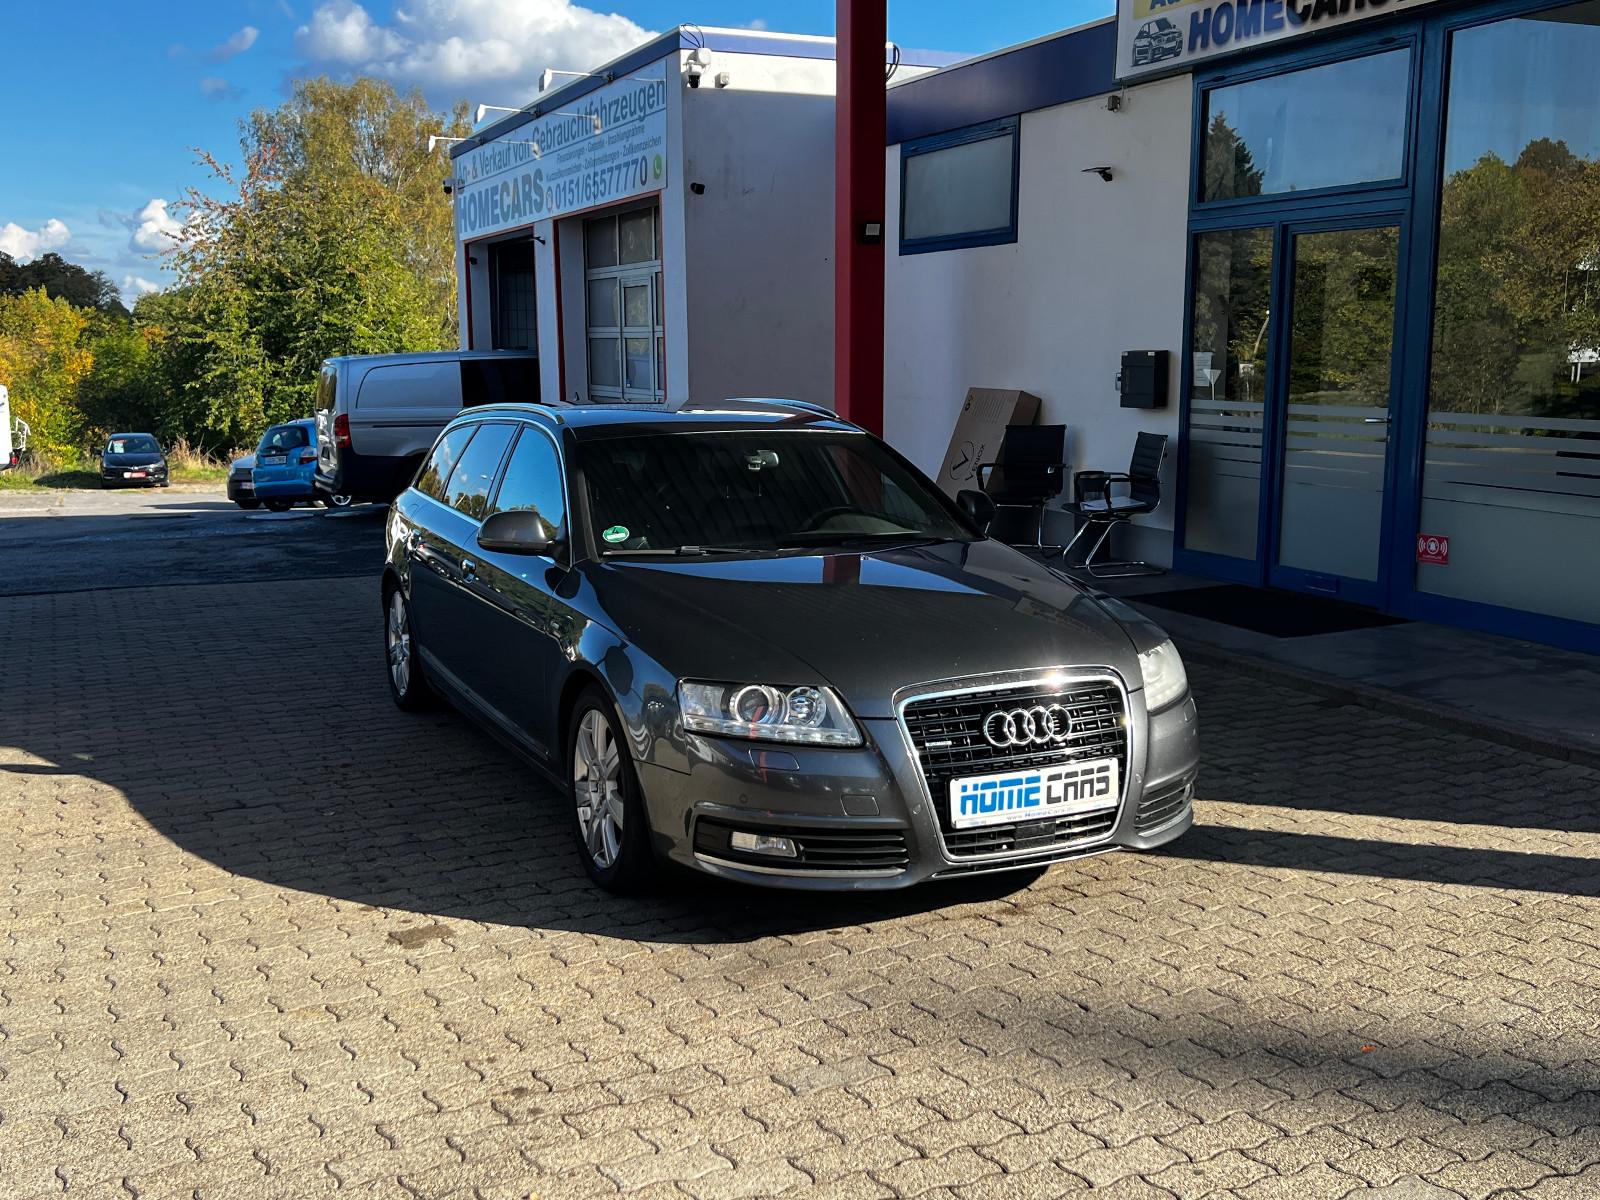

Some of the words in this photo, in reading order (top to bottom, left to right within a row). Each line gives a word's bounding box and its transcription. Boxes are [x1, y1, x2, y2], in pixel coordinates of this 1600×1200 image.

[1187, 0, 1386, 53] HOMEC
[471, 154, 478, 180] &
[479, 141, 511, 177] Verkauf
[512, 139, 530, 163] von
[457, 168, 544, 234] HOMECARS
[555, 155, 648, 209] 0151/65577770
[960, 775, 1041, 815] HOME
[1046, 765, 1110, 805] CARS
